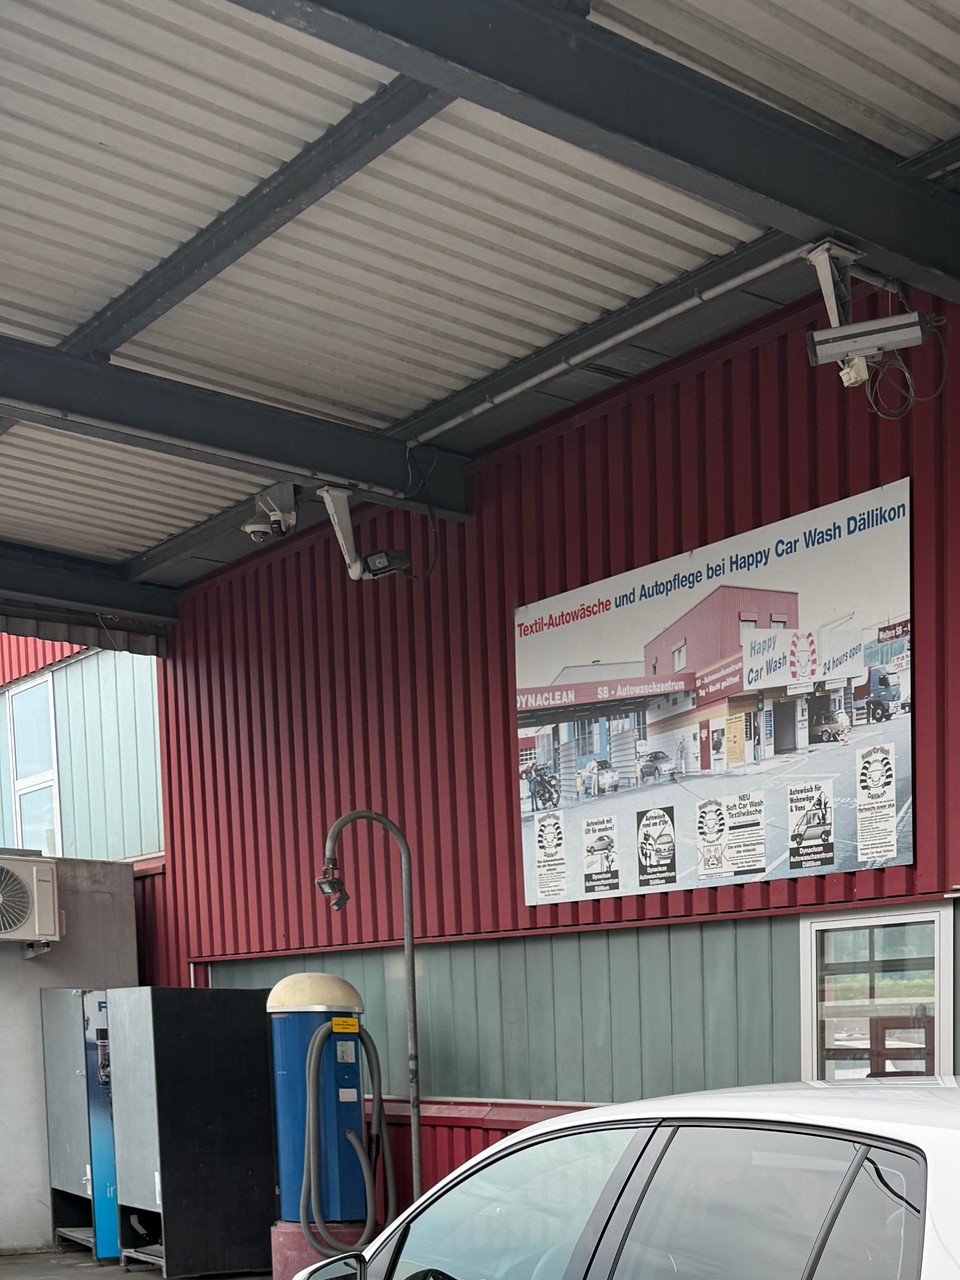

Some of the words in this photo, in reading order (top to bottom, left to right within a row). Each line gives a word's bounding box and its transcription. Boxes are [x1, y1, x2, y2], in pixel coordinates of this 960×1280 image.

[517, 598, 611, 638] Textil-Autowäsche
[614, 587, 636, 609] und
[639, 570, 702, 601] Autopflege
[706, 558, 725, 580] bei
[730, 548, 770, 573] Happy
[775, 538, 800, 557] Car
[803, 522, 842, 549] Wash
[847, 503, 906, 535] Dällikon
[750, 635, 777, 657] Happy
[832, 652, 848, 672] hours
[849, 643, 862, 661] open
[747, 667, 764, 685] Car
[766, 652, 787, 675] Wash
[597, 686, 609, 699] SB
[617, 680, 685, 697] Autowaschzentrum
